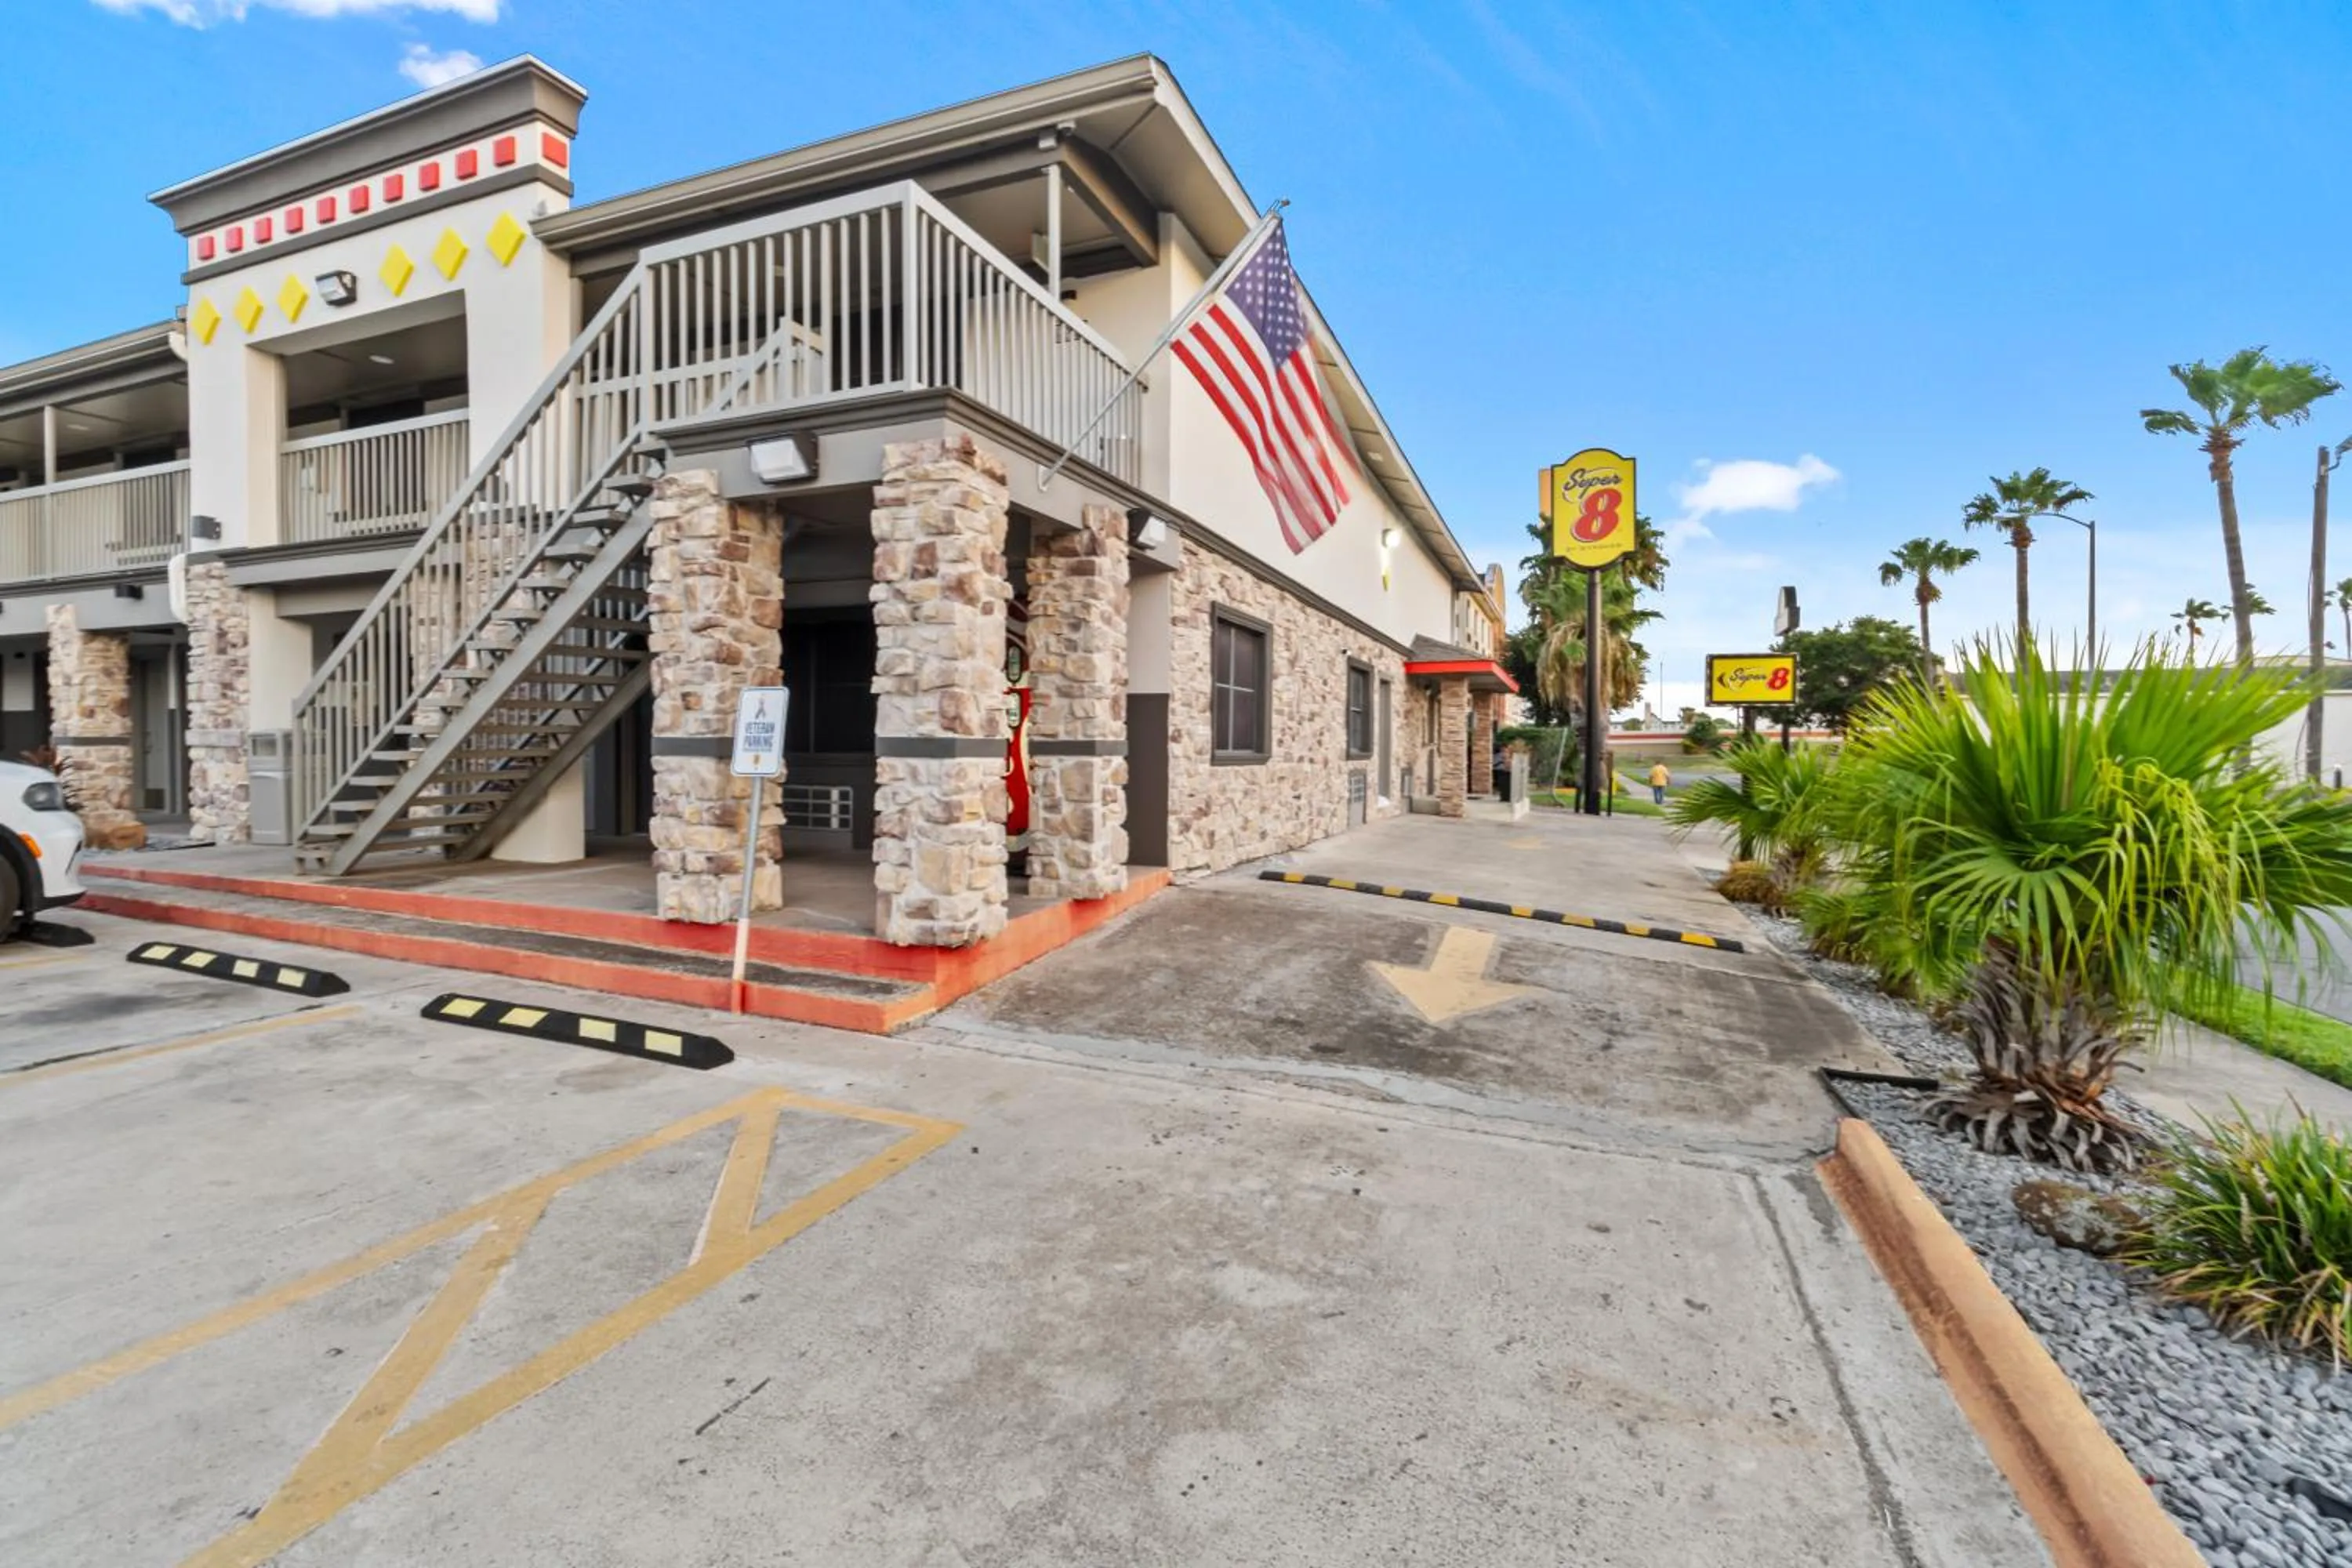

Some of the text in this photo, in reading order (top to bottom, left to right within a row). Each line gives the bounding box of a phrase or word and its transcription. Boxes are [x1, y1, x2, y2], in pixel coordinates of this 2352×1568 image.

[1563, 468, 1621, 499] Super
[1570, 488, 1622, 543] 8
[1730, 666, 1790, 690] Super 8
[744, 735, 774, 747] PARKING
